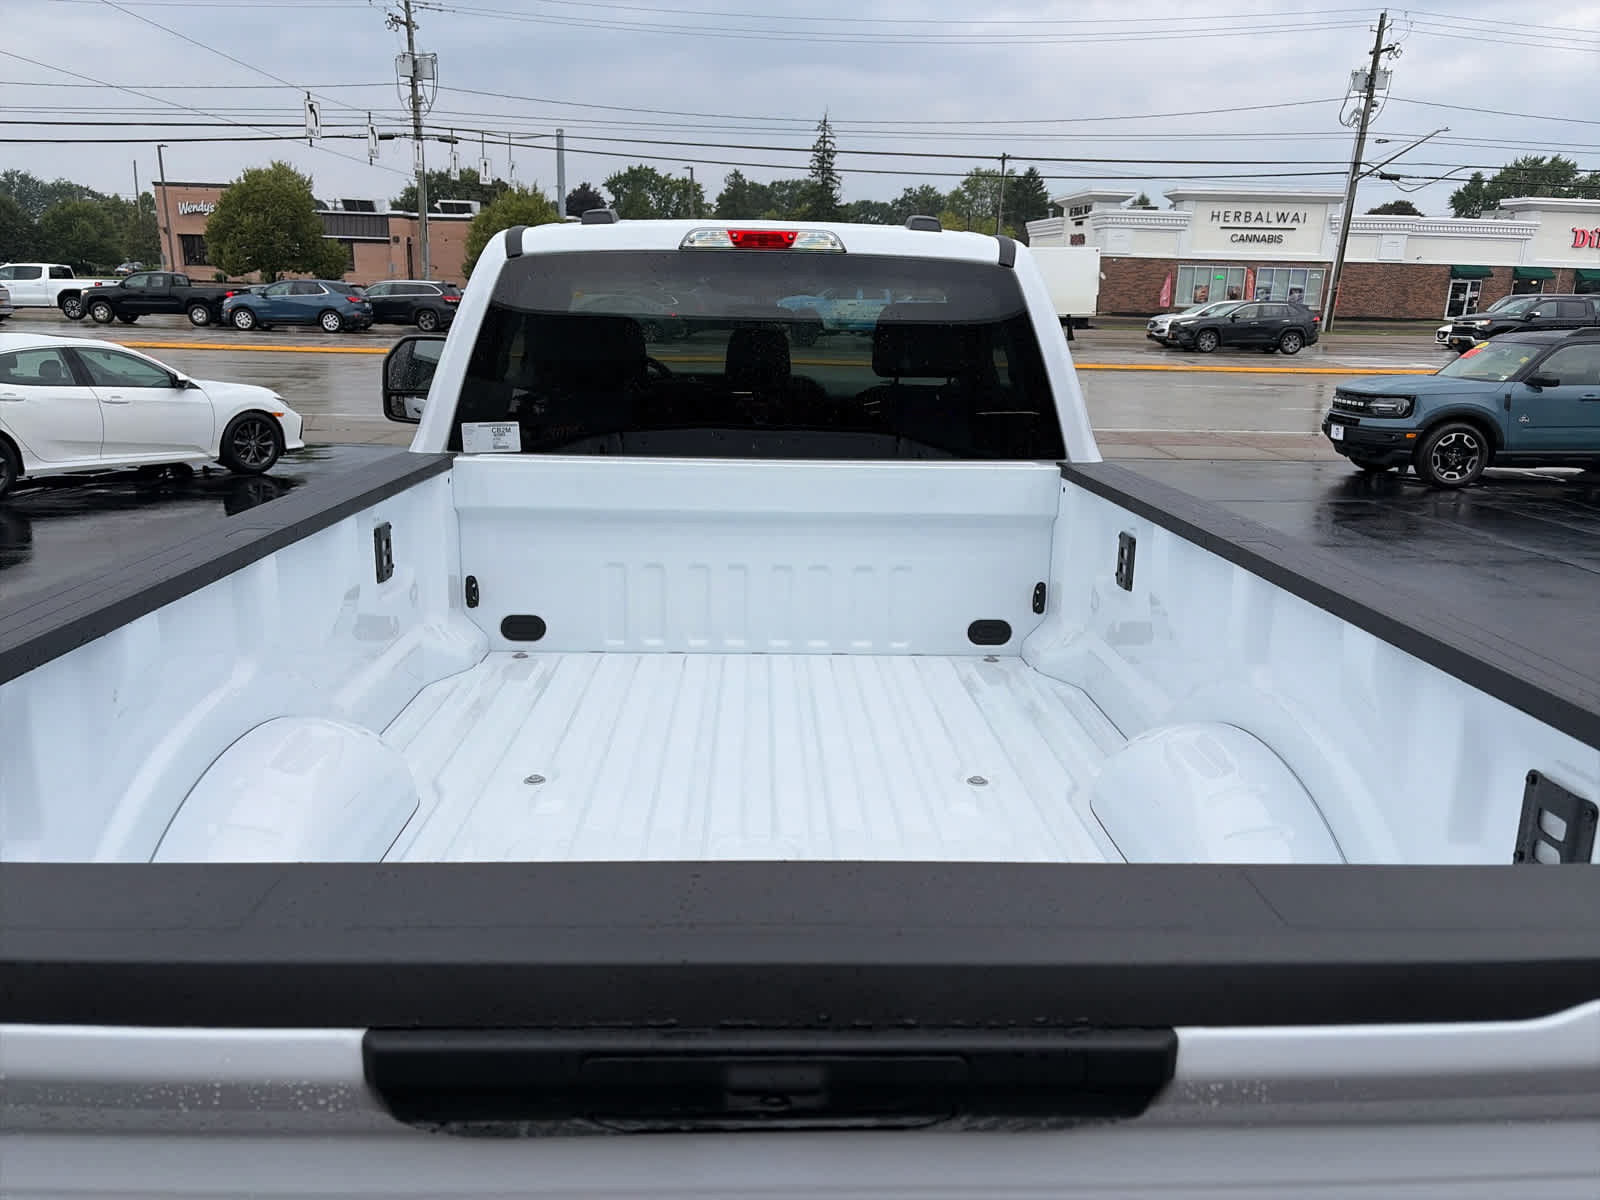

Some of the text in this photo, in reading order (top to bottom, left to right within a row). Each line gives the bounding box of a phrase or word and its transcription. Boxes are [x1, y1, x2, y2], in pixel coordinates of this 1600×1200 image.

[178, 200, 215, 216] Wendy's
[1210, 210, 1308, 224] HERBALWAI
[1230, 233, 1284, 244] CANNABIS
